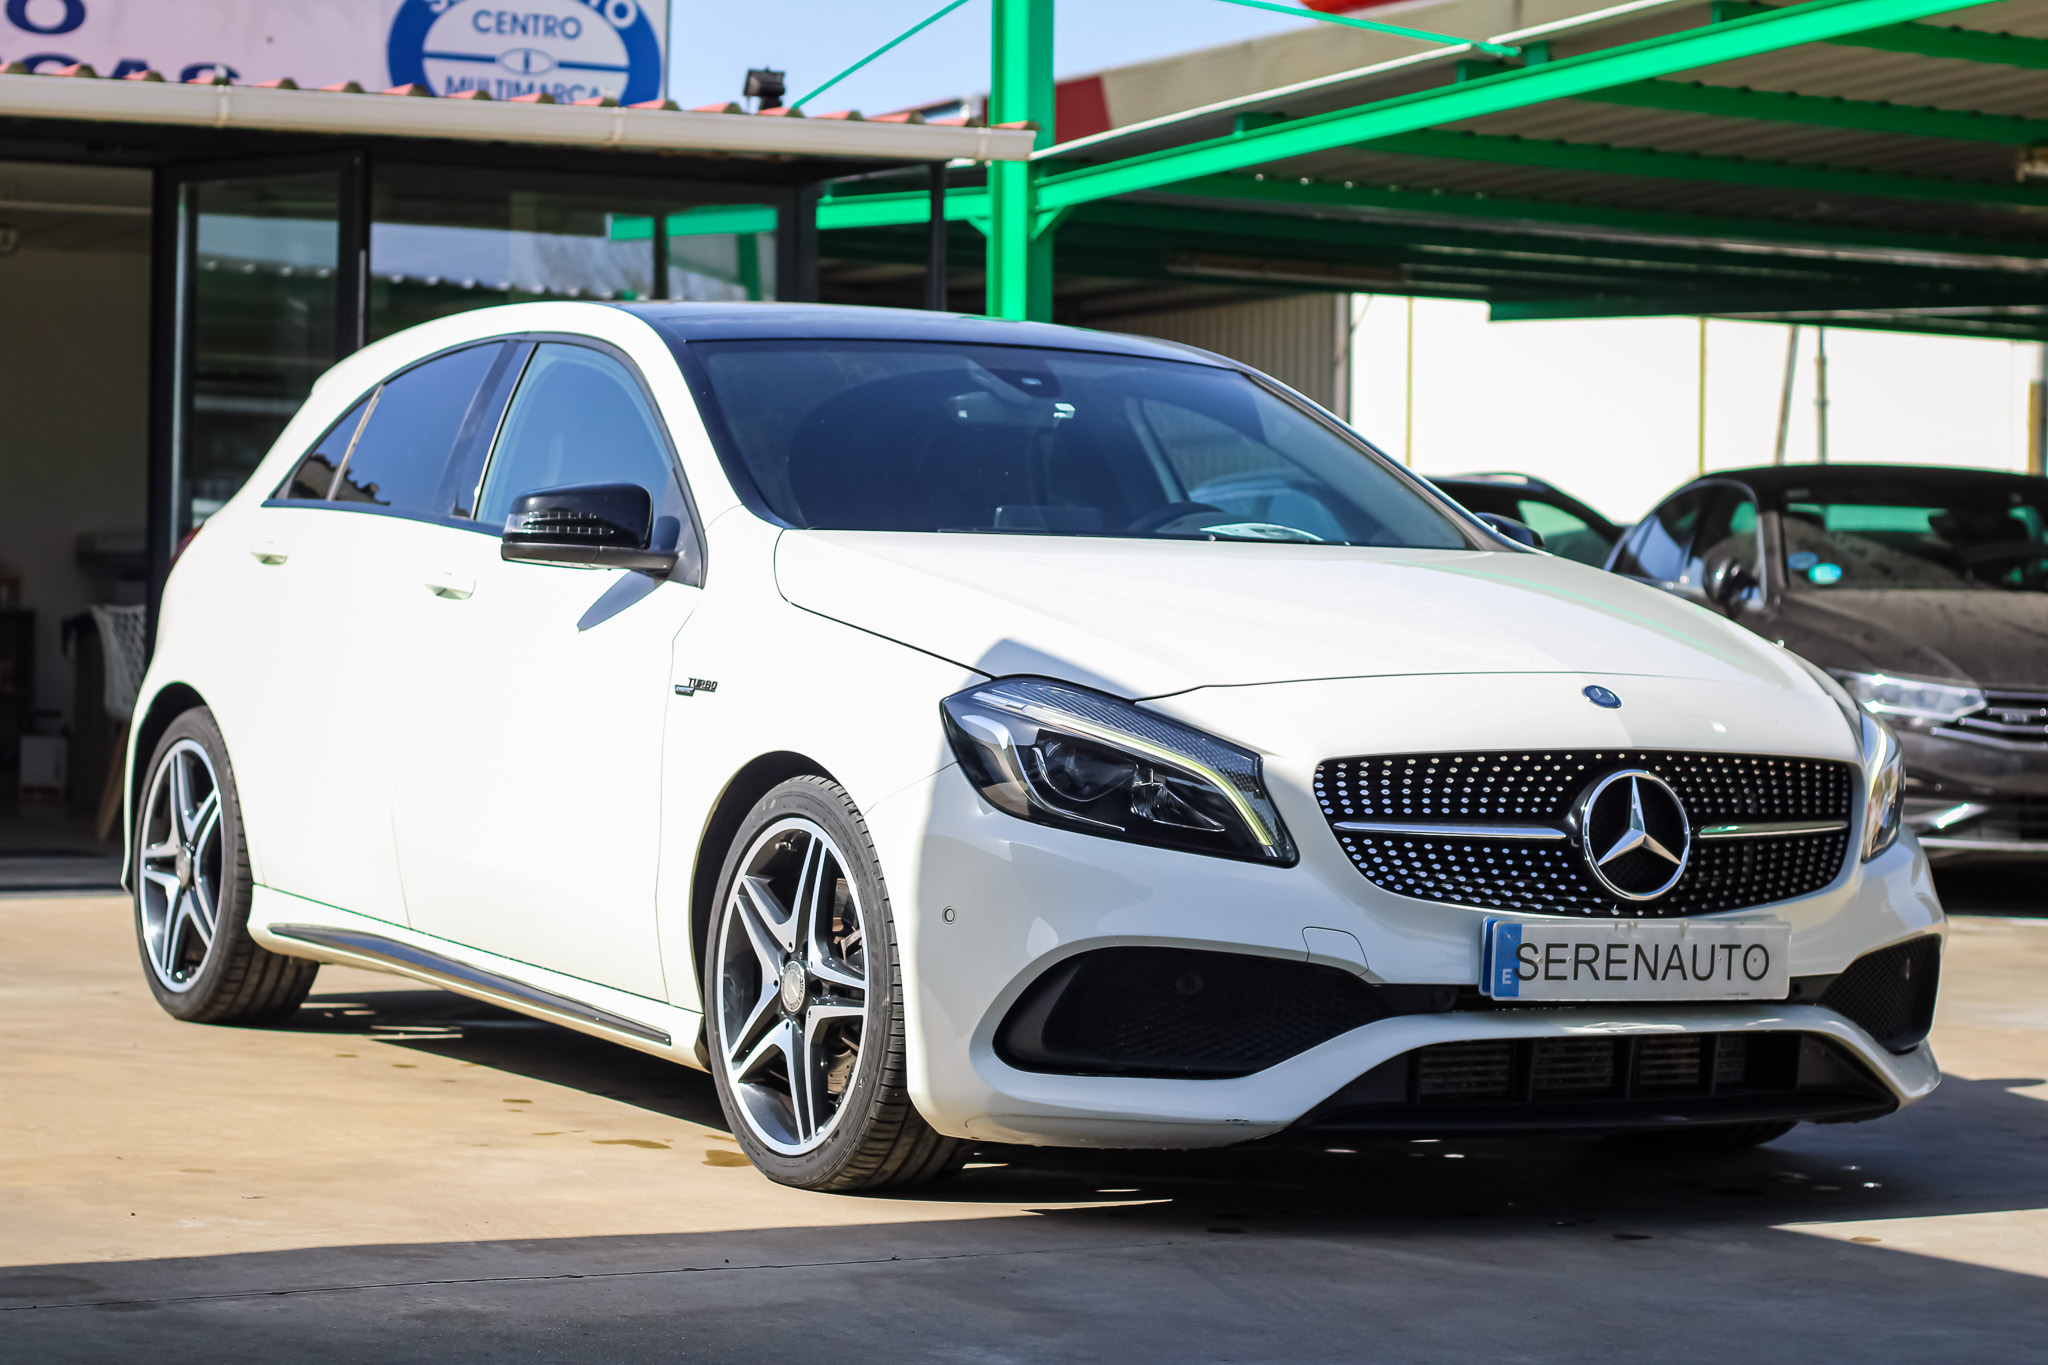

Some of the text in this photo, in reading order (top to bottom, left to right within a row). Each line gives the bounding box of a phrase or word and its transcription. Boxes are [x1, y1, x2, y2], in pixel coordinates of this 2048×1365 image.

[473, 10, 582, 39] CENTRO
[688, 677, 718, 691] TURBO
[1514, 942, 1770, 981] SERENAUTO
[1502, 968, 1513, 985] E
